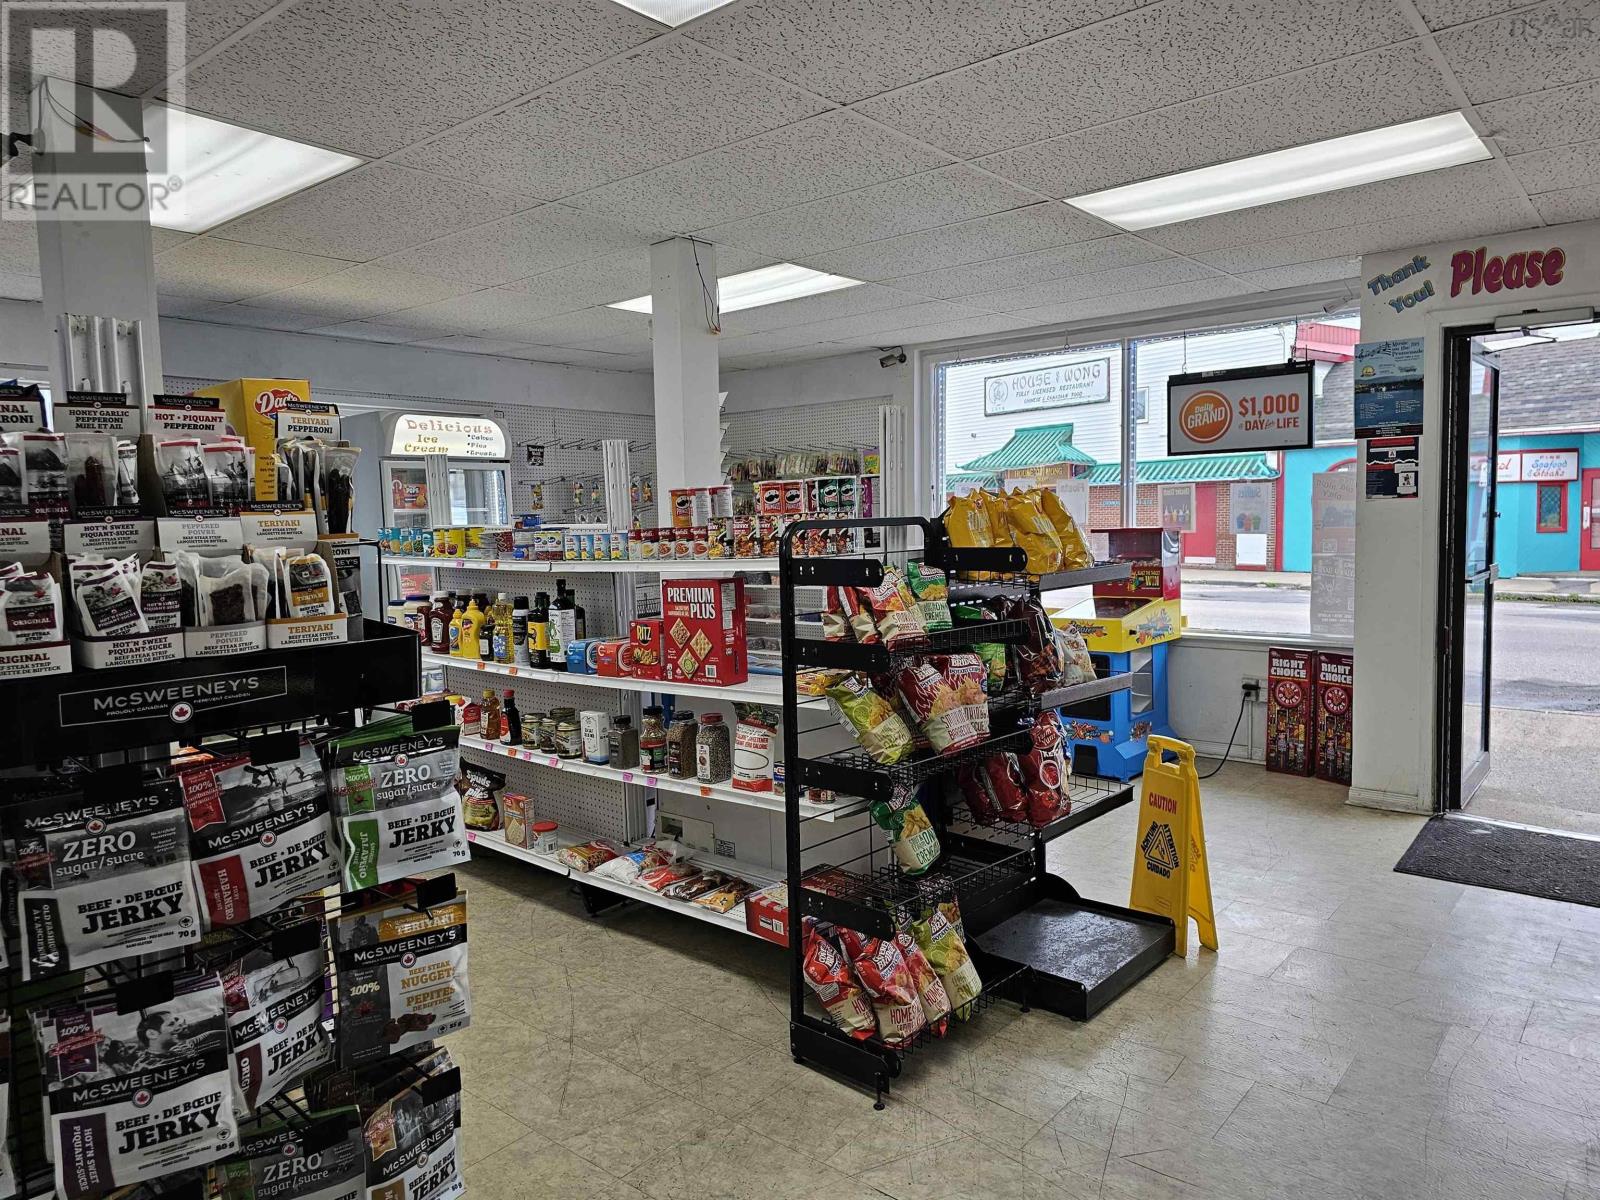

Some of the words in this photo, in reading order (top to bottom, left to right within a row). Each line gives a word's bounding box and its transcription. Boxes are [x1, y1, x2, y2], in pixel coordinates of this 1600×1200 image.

[1367, 254, 1431, 296] Thank
[1450, 246, 1566, 298] Please
[1388, 279, 1435, 314] You!
[1012, 372, 1051, 391] HOUSE
[1064, 364, 1101, 383] WONG
[1032, 386, 1056, 395] LICENSED
[1058, 381, 1094, 392] RESTAURANT
[1195, 402, 1214, 413] Daily
[1238, 393, 1300, 418] $1,000
[0, 415, 35, 424] RONI
[183, 415, 224, 423] PIQUANT
[291, 416, 330, 426] TERIYAKI
[1187, 406, 1226, 429] GRAND
[1245, 419, 1265, 431] DAY
[1276, 416, 1300, 429] LIFE
[163, 422, 215, 431] PEPPERONI
[288, 424, 333, 434] PEPPERONI
[405, 418, 493, 434] Delicious
[418, 434, 438, 444] Ice
[404, 443, 449, 454] Cream
[1531, 459, 1567, 471] Seafood
[1533, 469, 1565, 478] Steaks
[78, 508, 140, 517] McSWEENEY'S
[251, 502, 303, 510] McSWEENEY'S
[84, 524, 108, 532] HOT'N
[258, 519, 301, 528] TERIYAKI
[80, 530, 140, 538] PIQUANT-SUCRE
[667, 587, 715, 603] PREMIUM
[690, 603, 716, 619] PLUS
[13, 617, 51, 627] ORIGINAL
[288, 623, 334, 635] TERIYAKI
[210, 630, 249, 640] PEPPERED
[216, 637, 244, 645] POIVRE
[636, 626, 651, 641] RITZ
[108, 642, 173, 656] PIQUANT-SUCRE
[112, 640, 141, 649] HOT'N
[143, 637, 168, 646] SWEET
[195, 648, 230, 656] LANGUETTE
[7, 663, 30, 671] STEAK
[31, 661, 51, 669] STRIP
[105, 659, 143, 667] LANGUETTE
[152, 654, 176, 662] BIFTECK
[1272, 658, 1305, 669] RIGHT
[1321, 662, 1351, 675] RIGHT
[32, 665, 61, 674] BIFTECK
[1270, 667, 1307, 678] CHOICE
[1319, 671, 1352, 684] CHOICE
[93, 677, 260, 712] McSWEENEY'S
[106, 707, 136, 718] PROUDLY
[137, 702, 169, 713] CANADIAN
[352, 736, 444, 760] McSWEENEY'S
[380, 764, 431, 788] ZERO
[187, 780, 213, 795] 100%
[376, 780, 438, 804] sugar/sucre
[1148, 791, 1177, 815] CAUTION
[24, 795, 159, 829] McSWEENEY'S
[388, 817, 412, 830] BEEF
[420, 813, 433, 823] DE
[433, 805, 455, 819] BŒUF
[207, 803, 316, 850] McSWEENEY'S
[388, 815, 456, 849] JERKY
[62, 830, 136, 863] ZERO
[1162, 823, 1179, 869] ATTENTION
[249, 851, 278, 869] BEEF
[286, 844, 302, 856] DE
[254, 839, 331, 888] JERKY
[55, 850, 145, 880] sugar/sucre
[1146, 861, 1171, 879] CUIDADO
[78, 898, 112, 914] BEEF
[124, 893, 144, 905] DE
[145, 881, 183, 900] BŒUF
[216, 868, 236, 921] HABANERO
[42, 904, 51, 920] OLD
[82, 892, 184, 935] JERKY
[394, 911, 455, 935] TERIYAKI
[178, 930, 190, 938] 70
[191, 930, 197, 939] g
[353, 929, 457, 962] McSWEENEY'S
[408, 965, 427, 975] BEEF
[427, 960, 451, 971] STEAK
[349, 980, 381, 997] 100%
[406, 984, 456, 1007] PEPITES
[422, 996, 453, 1010] BIFTECK
[234, 987, 322, 1040] McSWEENEY'S
[59, 1023, 91, 1037] 100%
[266, 1038, 290, 1057] BEEF
[296, 1027, 309, 1038] DE
[72, 1059, 207, 1103] McSWEENEY'S
[115, 1114, 151, 1132] BEEF
[163, 1104, 182, 1119] DE
[182, 1091, 223, 1113] BŒUF
[119, 1103, 222, 1155] JERKY
[84, 1127, 97, 1157] HOT'N
[381, 1120, 455, 1176] McSWEENEY'S
[73, 1125, 90, 1192] PIQUANT-SUCRE
[87, 1158, 101, 1187] SWEET
[263, 1153, 322, 1185] ZERO
[257, 1169, 329, 1198] sugar/sucre
[407, 1171, 428, 1192] BEEF
